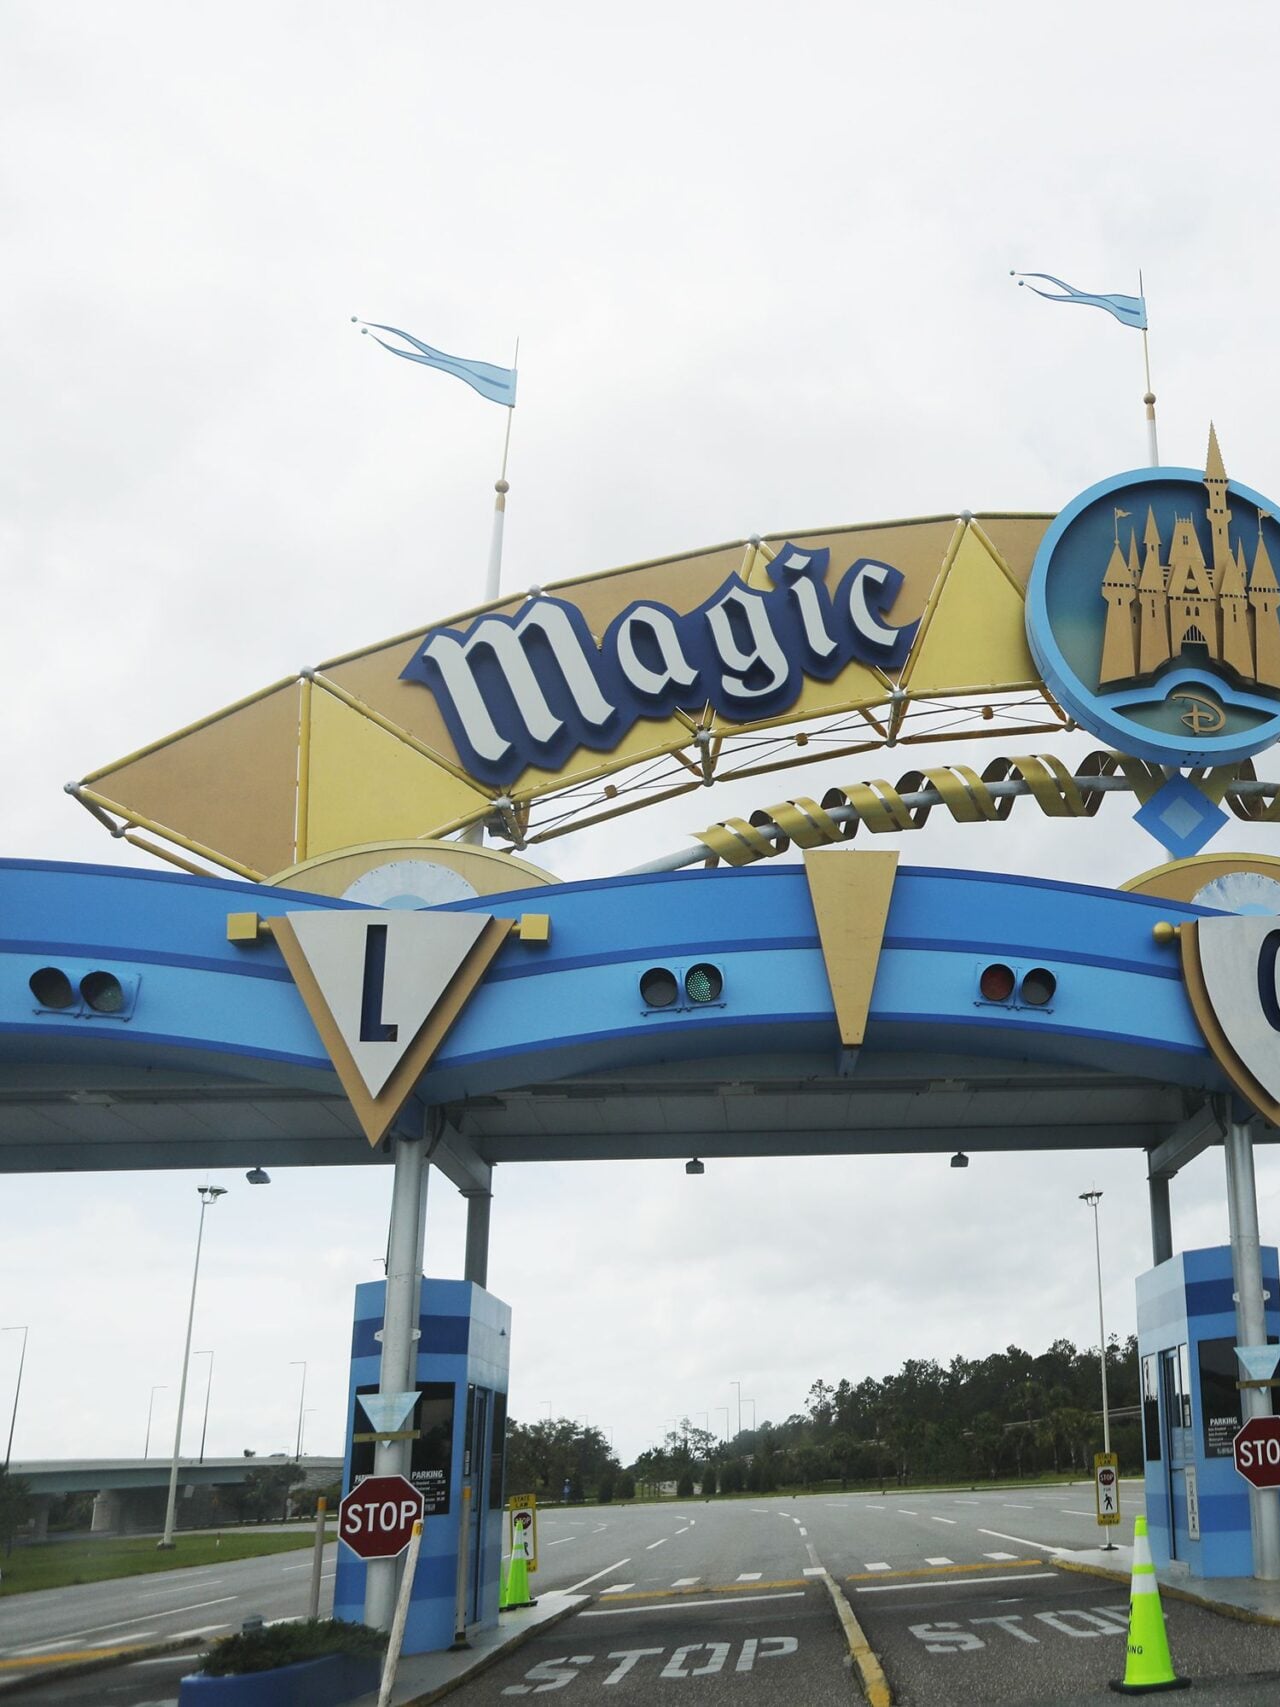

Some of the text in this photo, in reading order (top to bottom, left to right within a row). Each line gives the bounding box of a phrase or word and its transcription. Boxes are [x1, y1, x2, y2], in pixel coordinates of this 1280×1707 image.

[422, 552, 899, 761] Magic
[359, 924, 399, 1042] L
[1210, 1417, 1237, 1425] PARKING
[412, 1470, 443, 1479] PARKING
[1100, 1473, 1114, 1481] STOP
[345, 1500, 417, 1533] STOP
[501, 1636, 799, 1695] STOP
